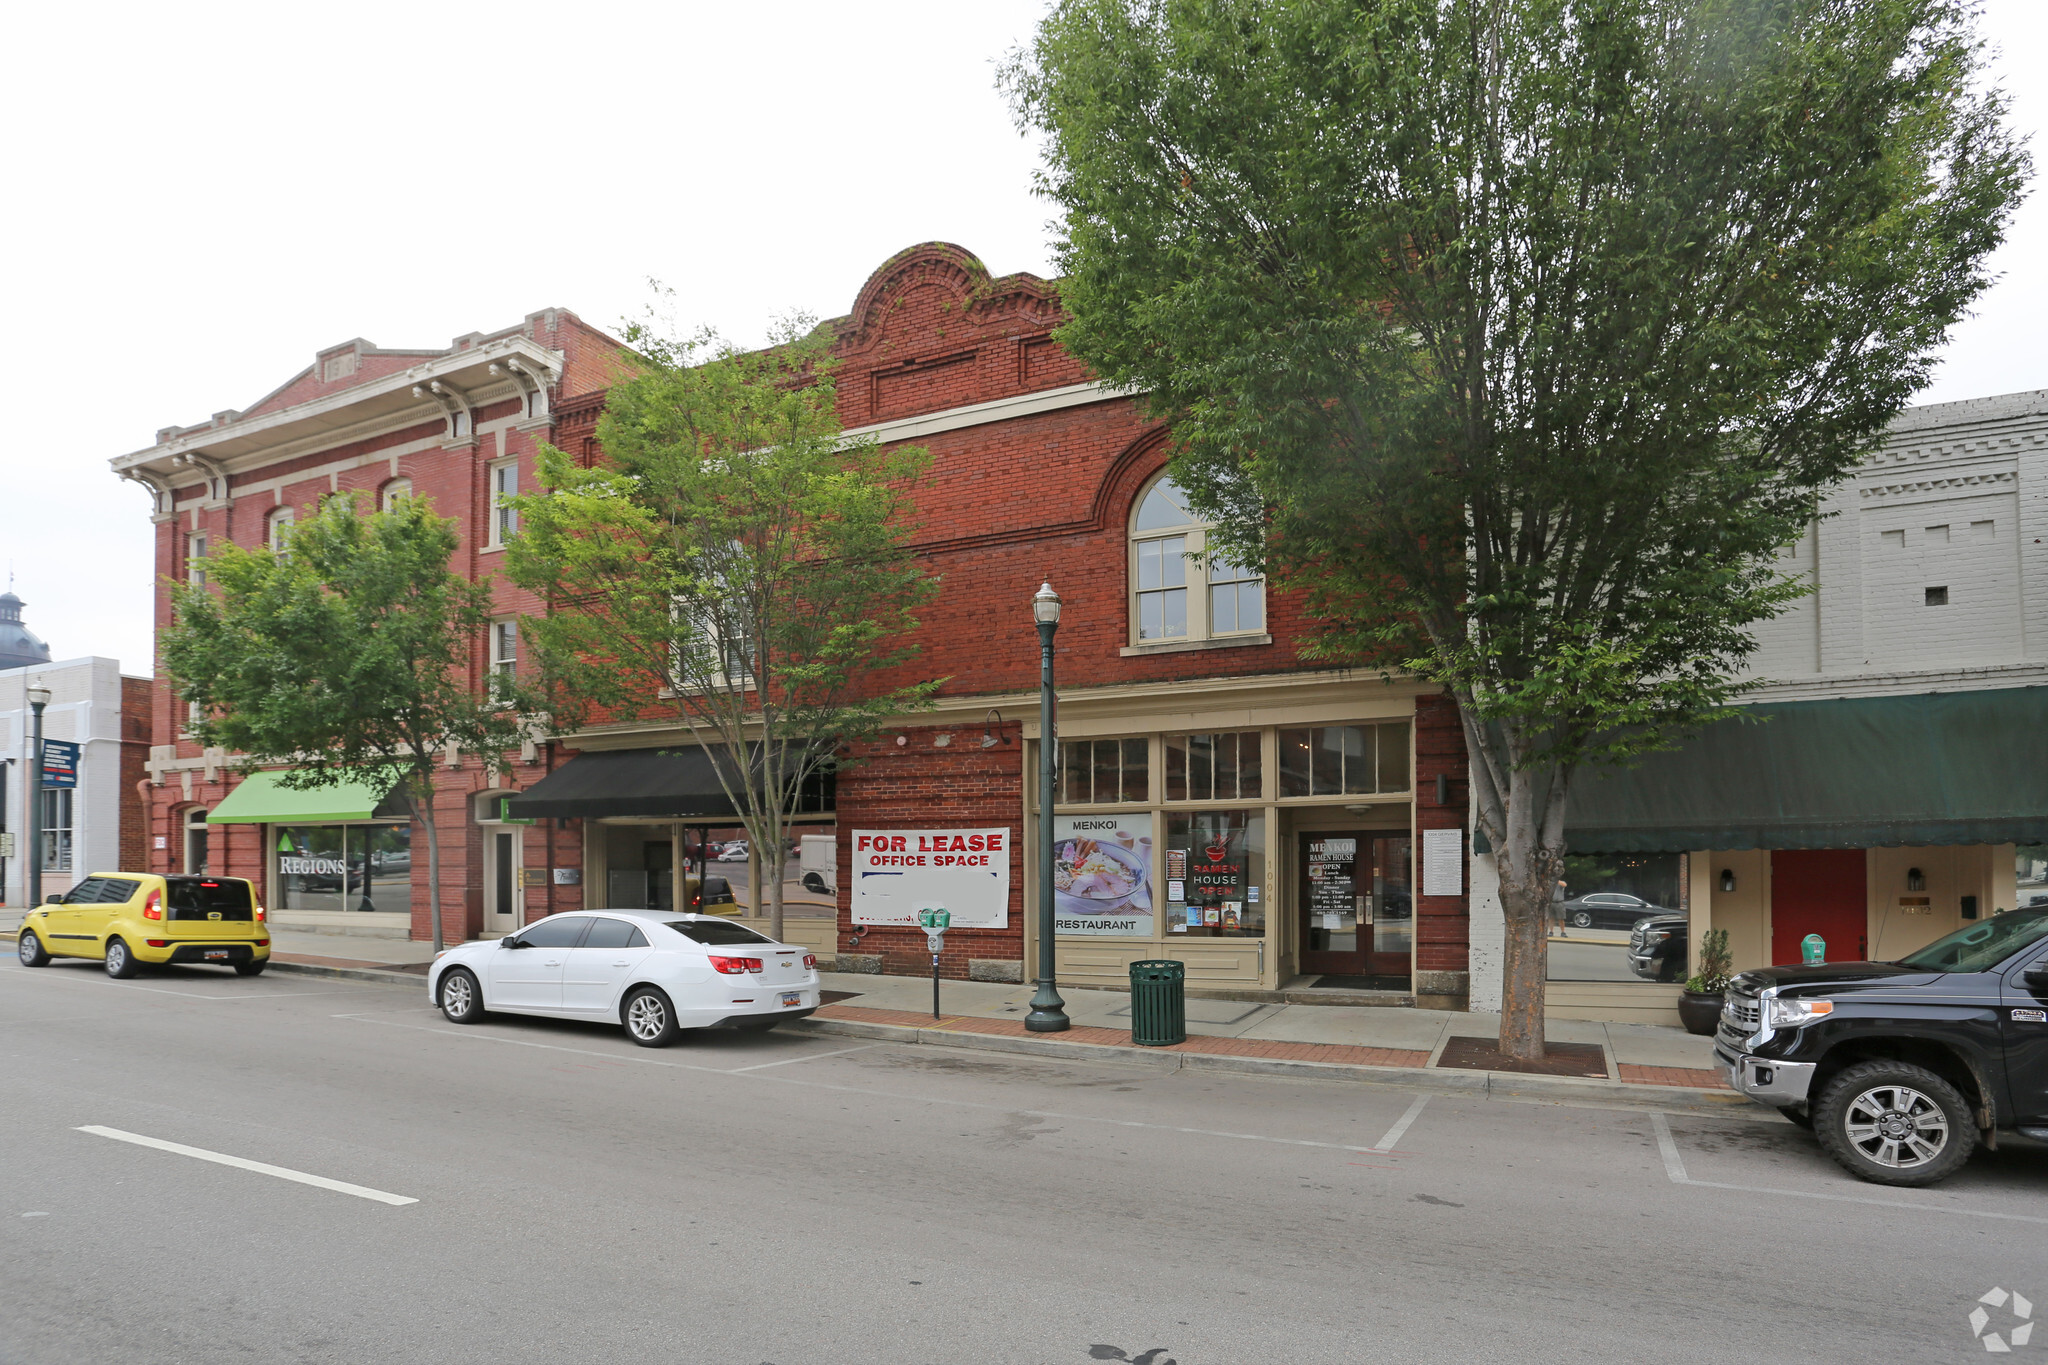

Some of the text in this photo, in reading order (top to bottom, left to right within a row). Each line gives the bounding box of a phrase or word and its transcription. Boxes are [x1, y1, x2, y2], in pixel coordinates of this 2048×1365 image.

[1072, 820, 1117, 830] MENKOI
[858, 834, 1003, 852] FOR LEASE
[1309, 842, 1354, 853] MENKOI
[869, 855, 990, 866] OFFICE SPACE
[1332, 853, 1354, 861] HOUSE
[279, 857, 345, 874] REGIONS
[1192, 864, 1240, 873] RAMEN
[1193, 875, 1237, 884] HOUSE
[1198, 886, 1236, 895] OPEN
[1056, 919, 1136, 930] RESTAURANT
